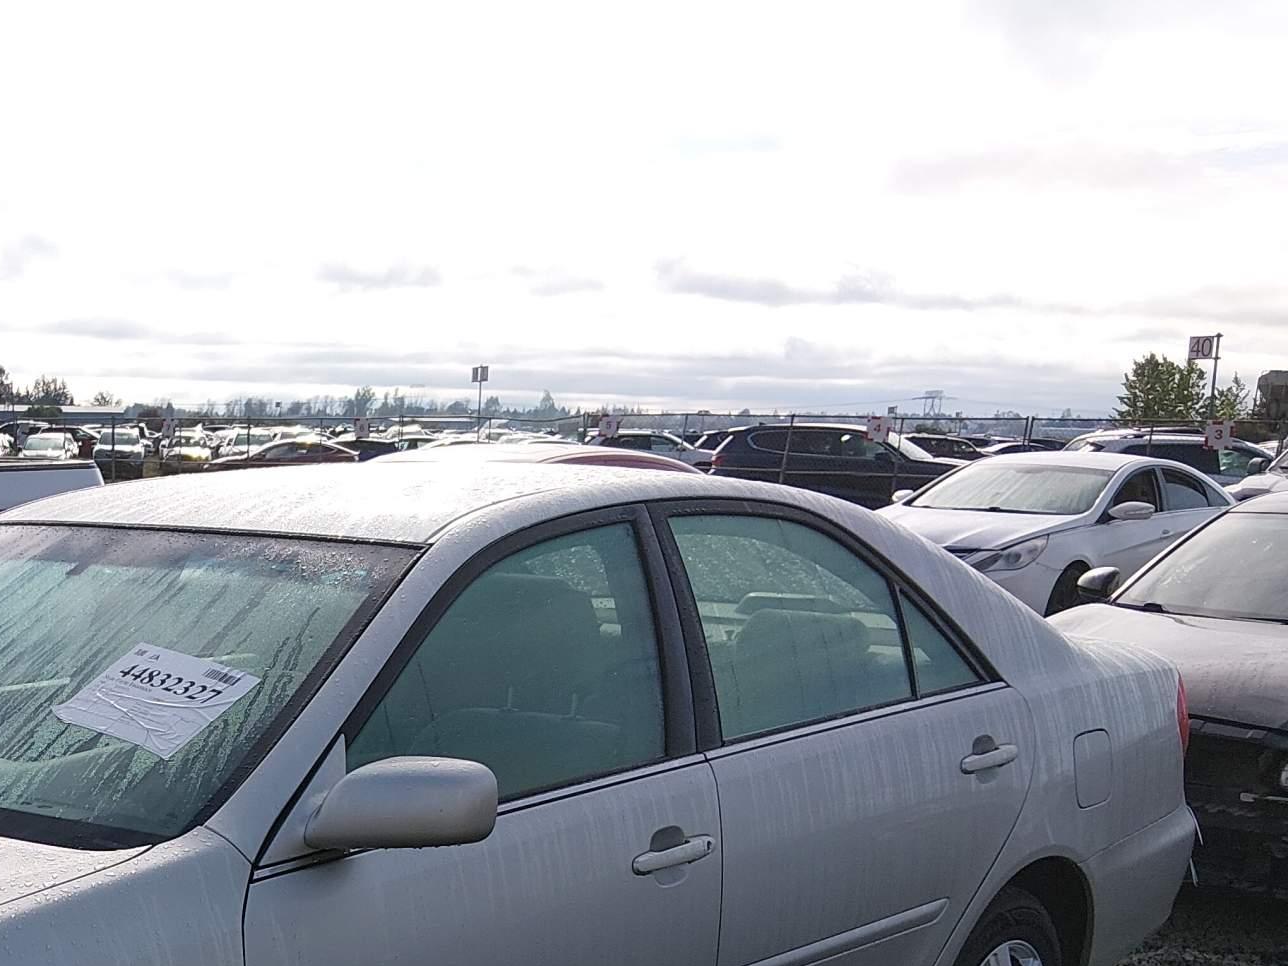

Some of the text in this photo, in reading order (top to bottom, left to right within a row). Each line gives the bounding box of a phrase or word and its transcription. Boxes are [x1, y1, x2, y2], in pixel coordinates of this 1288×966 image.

[1191, 338, 1212, 357] 40
[873, 423, 881, 432] 4
[1214, 429, 1223, 440] 3
[119, 664, 223, 704] 44832327
